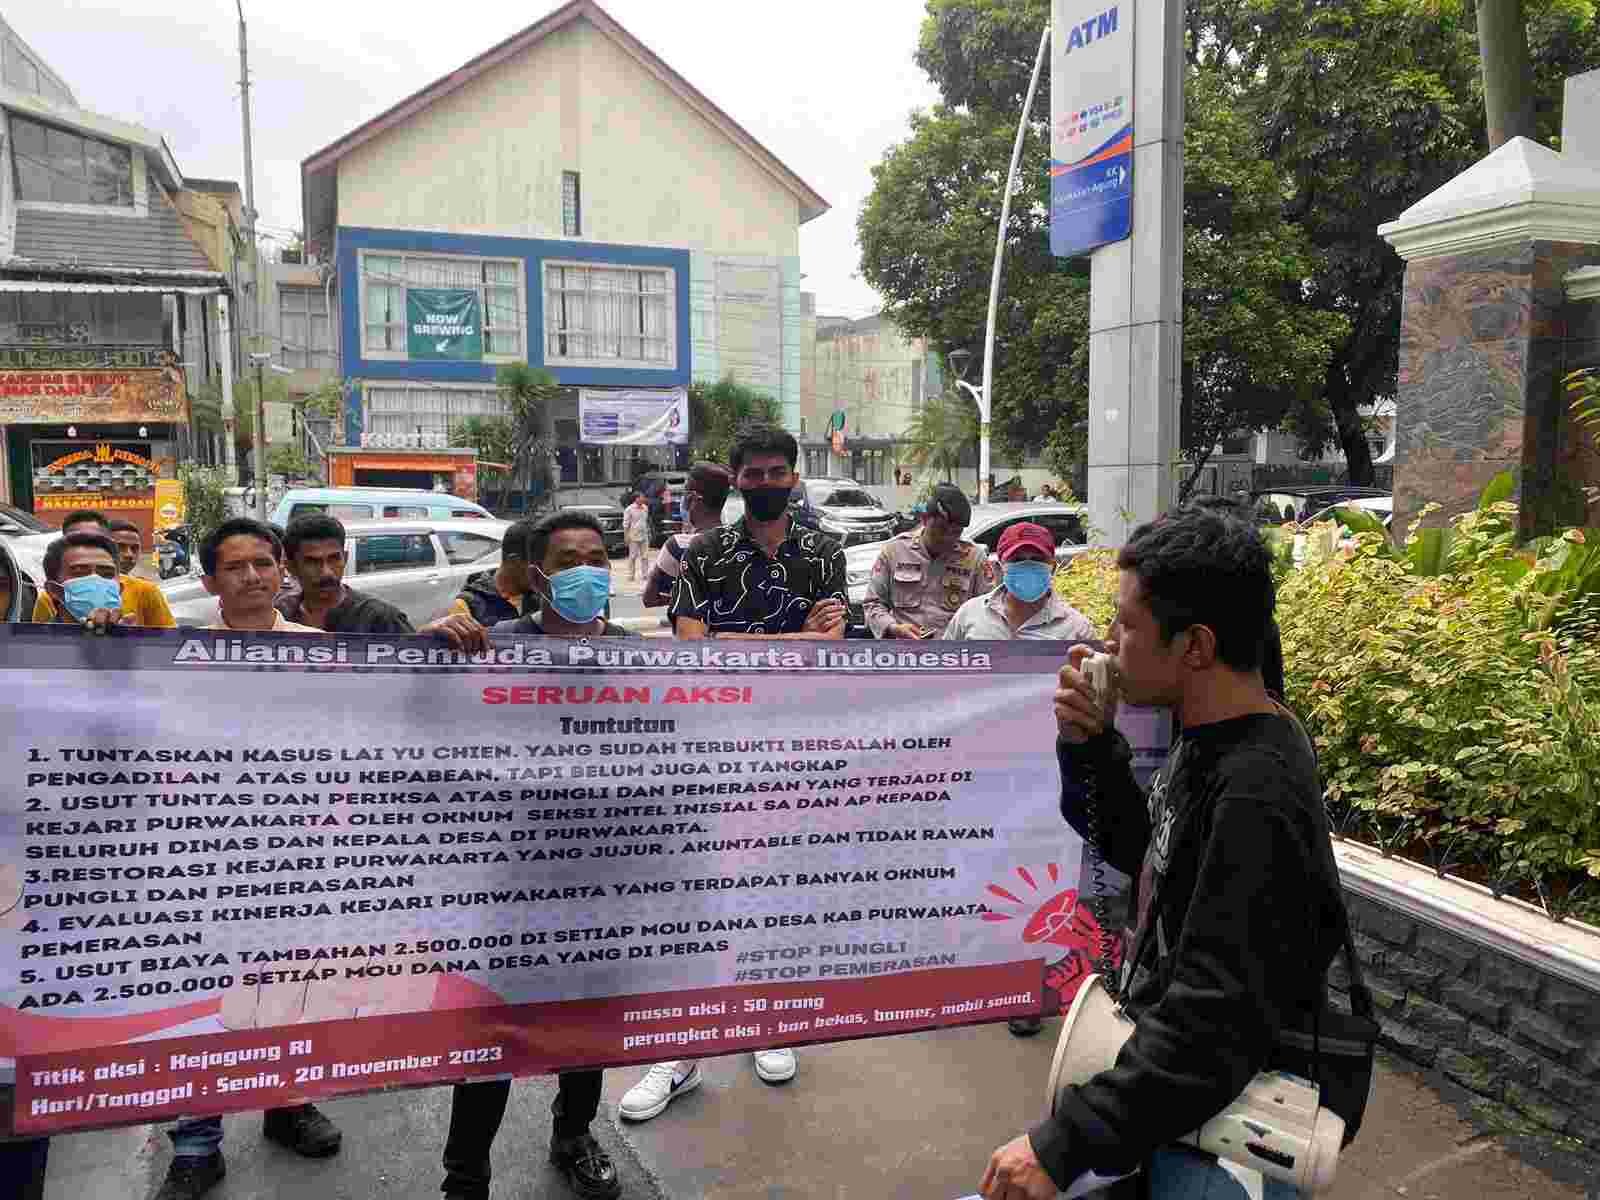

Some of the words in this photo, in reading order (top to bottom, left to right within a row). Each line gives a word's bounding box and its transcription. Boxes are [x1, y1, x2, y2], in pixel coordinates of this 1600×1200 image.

[1065, 7, 1118, 56] ATM
[413, 324, 474, 335] BREWING
[426, 314, 458, 324] NOW
[175, 639, 347, 662] Aliansi
[367, 643, 552, 664] Pemuda
[569, 645, 804, 667] Purwakarta
[817, 648, 991, 668] Indonesia
[481, 686, 651, 705] SERUAN
[661, 687, 752, 704] AKSI
[559, 716, 675, 735] Tuntutan
[28, 749, 50, 762] 1.
[59, 749, 233, 762] TUNTASKAN
[243, 749, 332, 762] KASUS
[341, 748, 384, 760] LAI
[392, 747, 424, 760] YU
[525, 744, 592, 757] YANG
[600, 742, 675, 756] SUDAH
[683, 740, 784, 754] TERBUKTI
[791, 738, 896, 751] BERSALAH
[903, 737, 951, 750] OLEH
[27, 771, 220, 787] PENGADILAN
[236, 772, 306, 784] ATAS
[316, 772, 350, 784] UU
[507, 766, 563, 780] TAPI
[570, 764, 644, 778] BELUM
[650, 762, 711, 776] JUGA
[718, 761, 742, 774] DI
[749, 759, 847, 773] TANGKAP
[25, 798, 50, 812] 2.
[61, 794, 137, 810] USUT
[145, 793, 253, 807] TUNTAS
[263, 793, 319, 805] DAN
[329, 792, 440, 805] PERIKSA
[448, 790, 512, 802] ATAS
[520, 787, 609, 801] PUNGLI
[616, 785, 665, 798] DAN
[672, 780, 799, 796] PEMERASAN
[806, 778, 861, 791] YANG
[866, 772, 946, 787] TERJADI
[951, 771, 972, 783] DI
[26, 819, 136, 836] KEJARI
[147, 814, 340, 831] PURWAKARTA
[348, 813, 414, 825] OLEH
[422, 811, 513, 823] OKNUM
[528, 808, 597, 821] SEKSI
[603, 805, 666, 818] INTEL
[672, 802, 757, 815] INISIAL
[763, 800, 790, 811] SA
[796, 797, 839, 809] DAN
[844, 795, 871, 807] AP
[876, 790, 951, 804] KEPADA
[24, 863, 217, 884] 3.RESTORASI
[226, 857, 326, 874] KEJARI
[334, 851, 510, 868] PURWAKARTA
[516, 847, 584, 862] YANG
[589, 843, 663, 858] JUJUR
[681, 834, 801, 854] AKUNTABLE
[808, 831, 850, 845] DAN
[856, 829, 917, 843] TIDAK
[922, 827, 994, 841] RAWAN
[25, 842, 159, 859] SELURUH
[168, 837, 258, 854] DINAS
[268, 836, 324, 849] DAN
[333, 833, 431, 847] KEPALA
[439, 830, 502, 844] DESA
[510, 829, 537, 842] DI
[545, 822, 708, 840] PURWAKARTA.
[21, 920, 48, 933] 4.
[58, 910, 203, 930] EVALUASI
[212, 903, 332, 922] KINERJA
[340, 896, 433, 914] KEJARI
[441, 884, 607, 907] PURWAKARTA
[613, 880, 675, 896] YANG
[681, 874, 790, 891] TERDAPAT
[796, 868, 879, 886] BANYAK
[884, 867, 955, 881] OKNUM
[24, 890, 136, 908] PUNGLI
[147, 887, 207, 902] DAN
[217, 875, 415, 898] PEMERASARAN
[20, 969, 45, 984] 5.
[55, 961, 132, 980] USUT
[141, 953, 229, 972] BIAYA
[237, 944, 386, 964] TAMBAHAN
[394, 935, 512, 955] 2.500.000
[520, 933, 546, 945] DI
[554, 926, 634, 943] SETIAP
[641, 921, 690, 937] MOU
[697, 918, 757, 932] DANA
[765, 914, 816, 928] DESA
[823, 910, 862, 924] KAB
[22, 932, 201, 958] PEMERASAN
[736, 946, 811, 963] #STOP
[819, 941, 907, 957] PUNGLI
[18, 991, 84, 1009] ADA
[93, 974, 233, 1001] 2.500.000
[242, 968, 336, 986] SETIAP
[345, 963, 402, 979] MOU
[411, 958, 481, 975] DANA
[489, 954, 550, 970] DESA
[557, 948, 620, 964] YANG
[628, 946, 653, 959] DI
[660, 940, 729, 956] PERAS
[735, 965, 811, 982] #STOP
[819, 953, 956, 977] PEMERASAN
[623, 1026, 719, 1050] perangkat
[724, 1024, 760, 1038] aksi
[31, 1071, 85, 1086] Titik
[94, 1059, 145, 1080] aksi
[170, 1044, 280, 1071] Kejagung
[289, 1040, 312, 1056] RI
[31, 1083, 193, 1115] Hari/Tanggal
[216, 1073, 287, 1093] Senin,
[295, 1066, 323, 1082] 20
[332, 1054, 442, 1077] November
[449, 1047, 503, 1064] 2023
